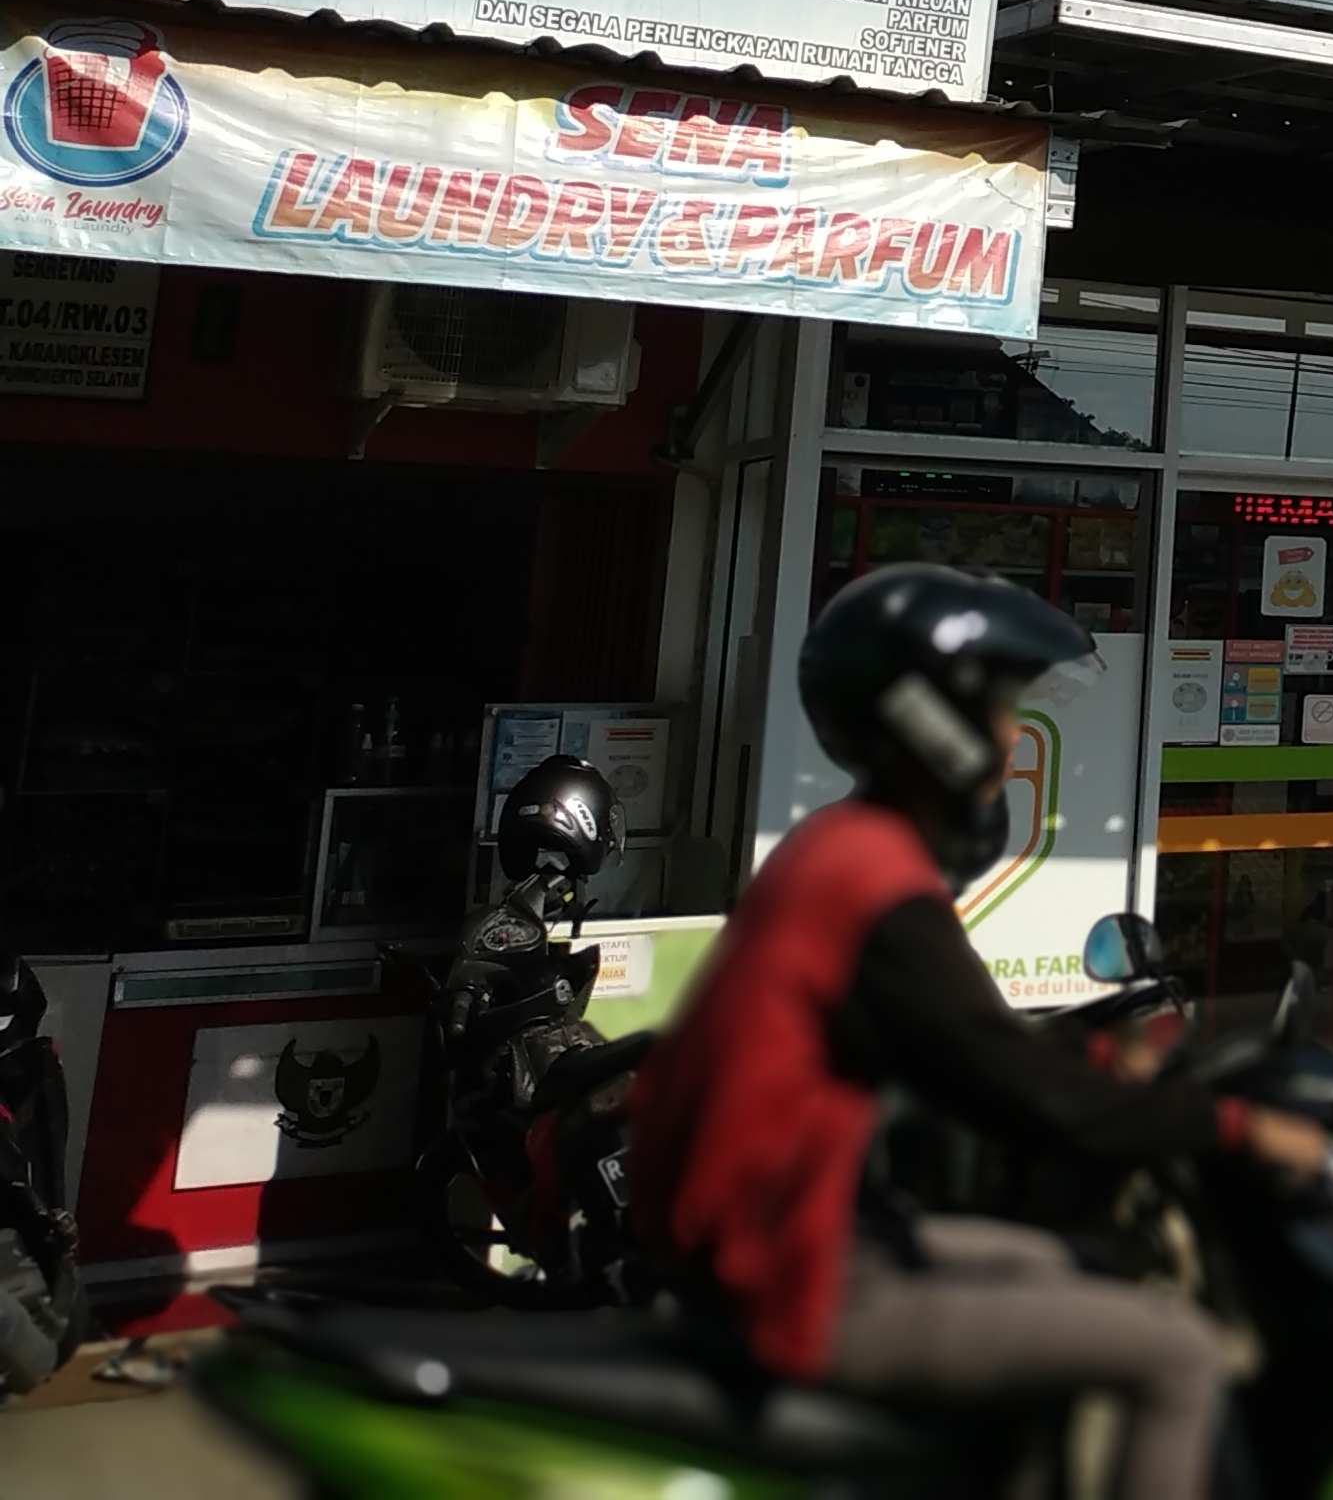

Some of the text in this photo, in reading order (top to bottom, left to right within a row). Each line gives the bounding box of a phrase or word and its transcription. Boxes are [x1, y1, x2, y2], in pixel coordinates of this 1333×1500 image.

[887, 8, 969, 39] PARFUM
[529, 3, 622, 40] SEGALA
[622, 18, 800, 62] PERLENGKAPAN
[801, 41, 877, 74] RUMAH
[879, 56, 964, 86] TANGGA
[860, 28, 966, 63] SOFTENER
[545, 82, 792, 188] SENA
[63, 191, 164, 229] Laundry
[252, 148, 660, 270] LAUNDRY
[708, 208, 1022, 306] PARFUM
[576, 803, 595, 834] INK
[1034, 954, 1085, 977] FAR
[605, 1159, 625, 1181] R
